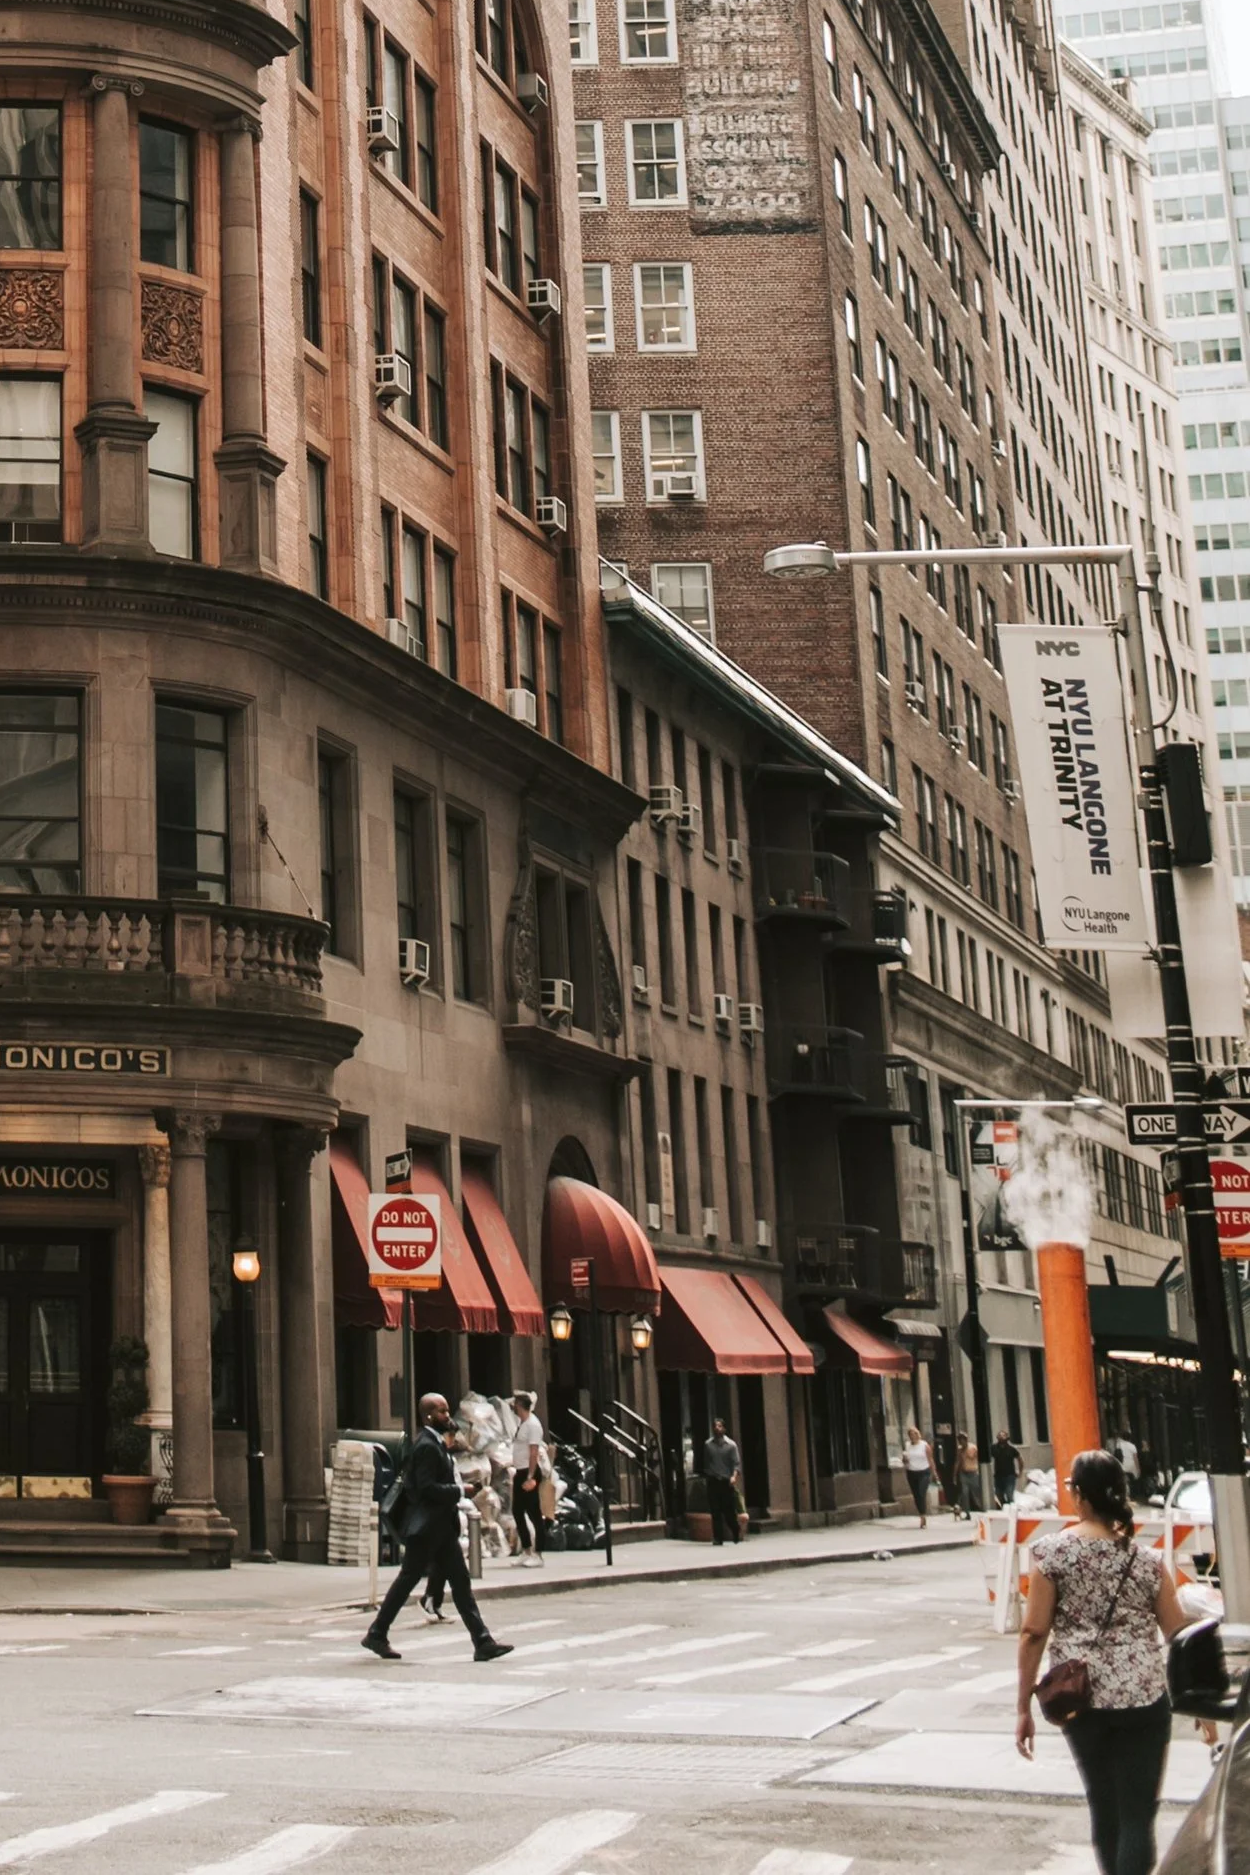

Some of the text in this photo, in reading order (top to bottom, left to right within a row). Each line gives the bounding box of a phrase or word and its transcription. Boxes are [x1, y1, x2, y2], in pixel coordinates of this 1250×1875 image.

[1035, 640, 1081, 657] NYC
[1040, 677, 1083, 832] AT TRINITY
[1064, 678, 1112, 876] NYU LANGONE
[1064, 906, 1131, 923] NYU Langone
[1084, 921, 1118, 934] Health
[1138, 1116, 1176, 1132] ONE
[1221, 1175, 1250, 1188] NOT
[382, 1211, 427, 1224] DO NOT
[1215, 1211, 1250, 1225] NTER
[383, 1245, 426, 1258] ENTER
